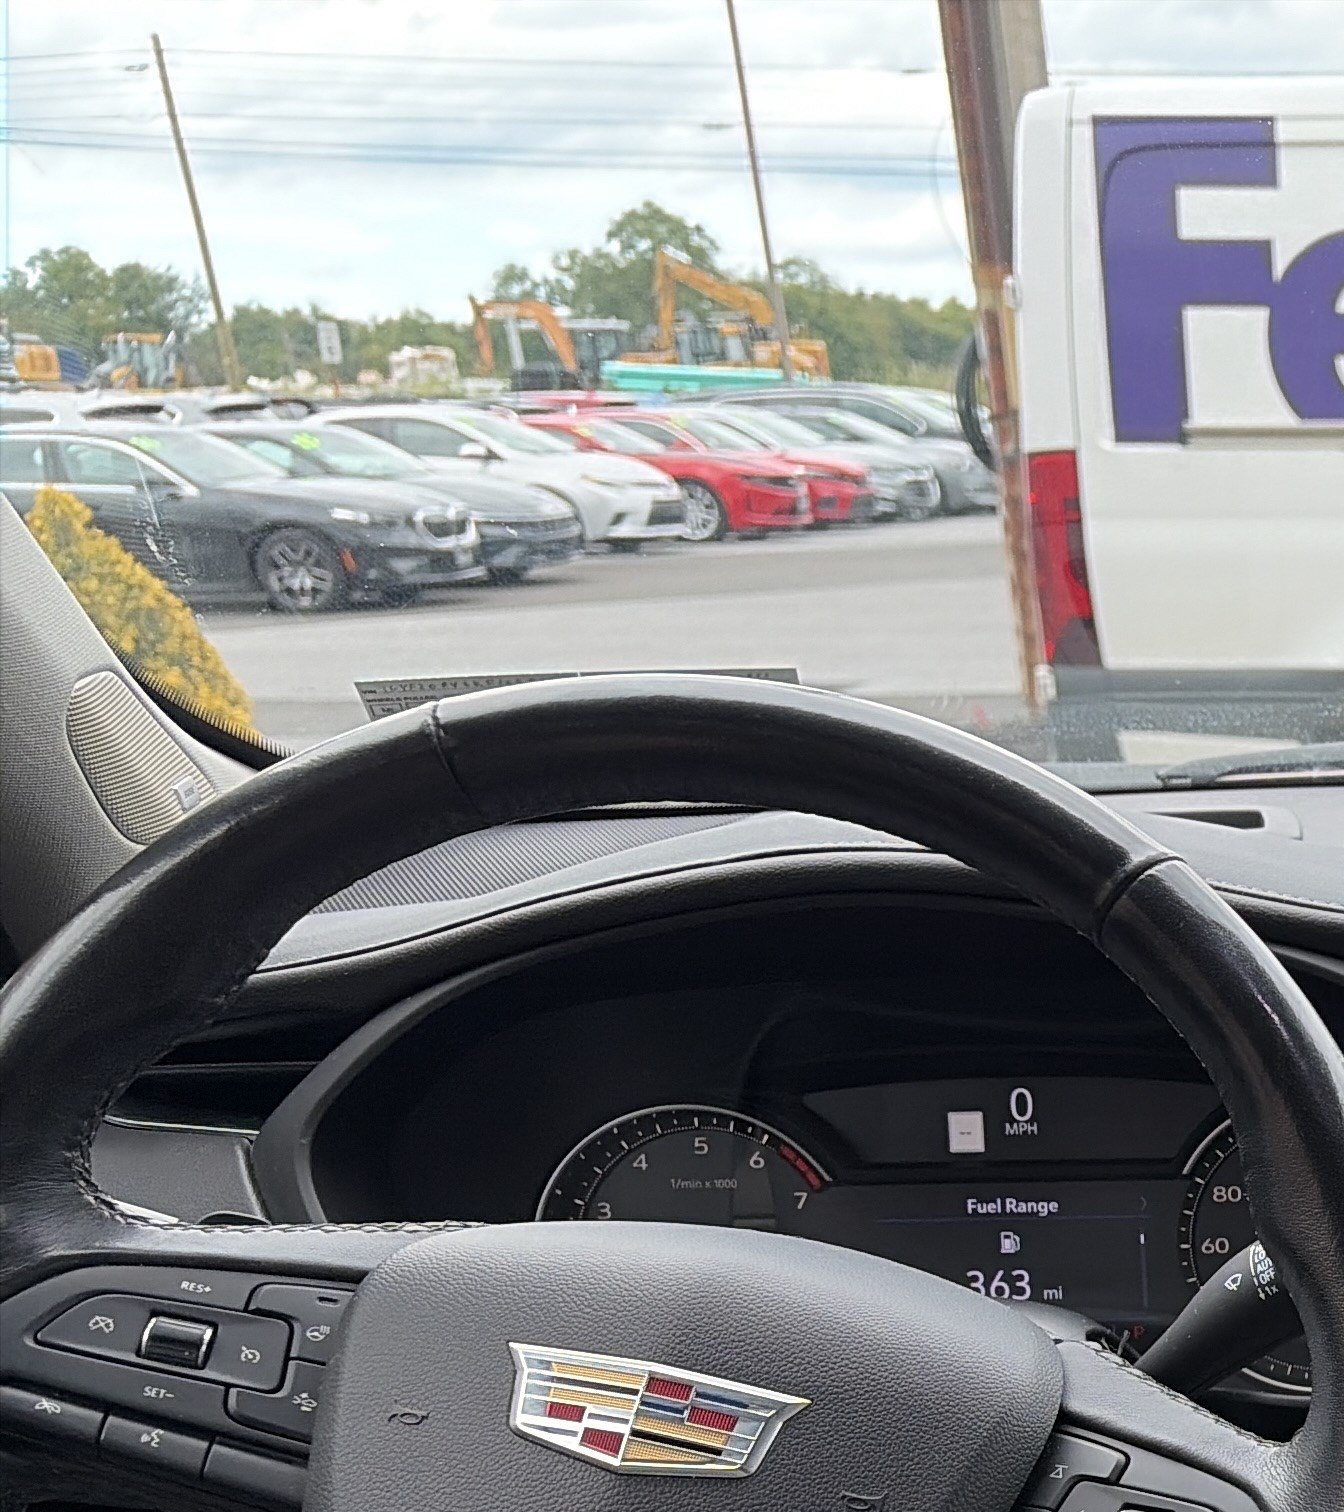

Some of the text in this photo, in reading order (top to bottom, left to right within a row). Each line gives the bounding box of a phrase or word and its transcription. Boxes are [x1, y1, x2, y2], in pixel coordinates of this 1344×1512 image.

[1010, 1087, 1033, 1121] 0
[1005, 1122, 1038, 1135] MPH
[694, 1137, 708, 1154] 5
[633, 1153, 648, 1170] 4
[750, 1151, 765, 1168] 6
[714, 1178, 737, 1188] 1000
[794, 1192, 808, 1209] 7
[1212, 1186, 1242, 1202] 80
[598, 1202, 611, 1219] 3
[967, 1198, 1059, 1216] Fuel Range
[1201, 1238, 1229, 1254] 60
[1259, 1267, 1275, 1284] OFF
[181, 1280, 212, 1293] RES+
[966, 1269, 1063, 1300] 363 mi
